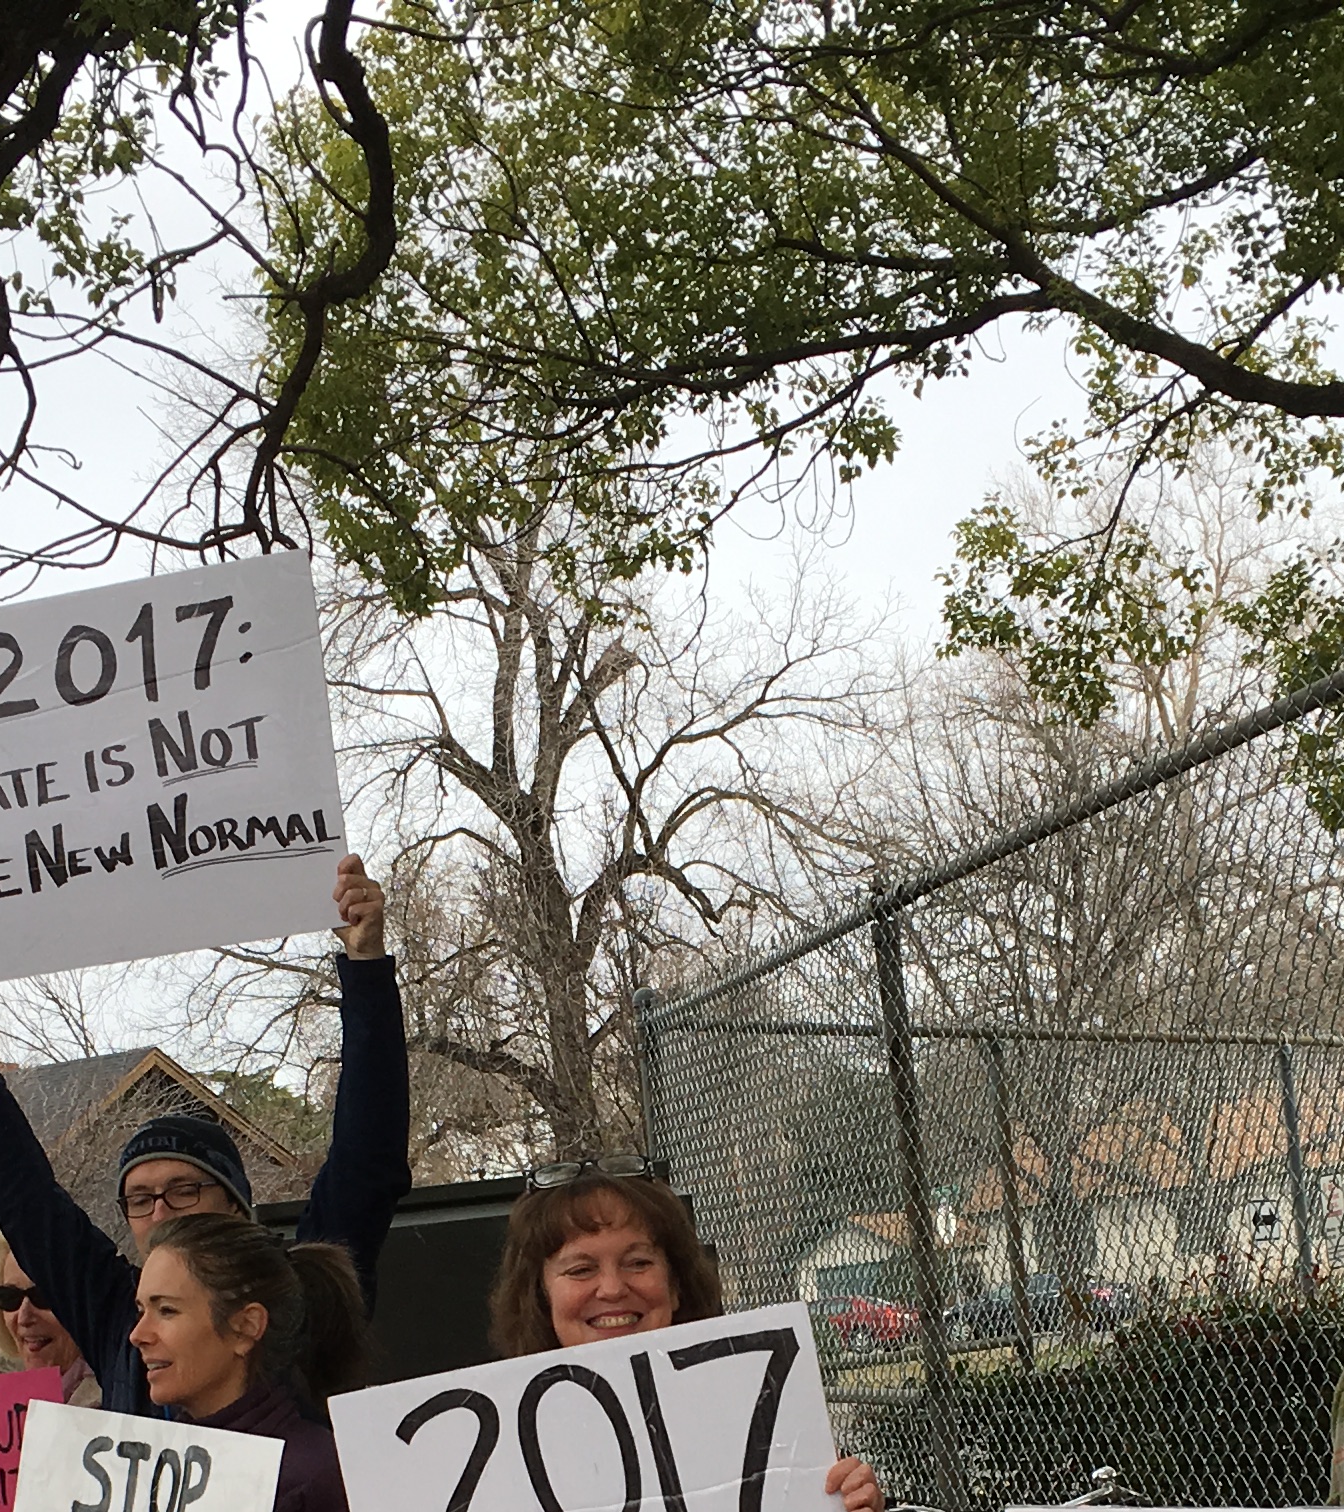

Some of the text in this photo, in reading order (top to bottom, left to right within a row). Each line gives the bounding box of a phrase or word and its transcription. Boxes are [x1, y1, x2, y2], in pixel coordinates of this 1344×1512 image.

[84, 744, 135, 793] IS
[148, 711, 268, 780] NOT
[25, 824, 133, 894] NEW
[146, 793, 341, 871] NORMAL
